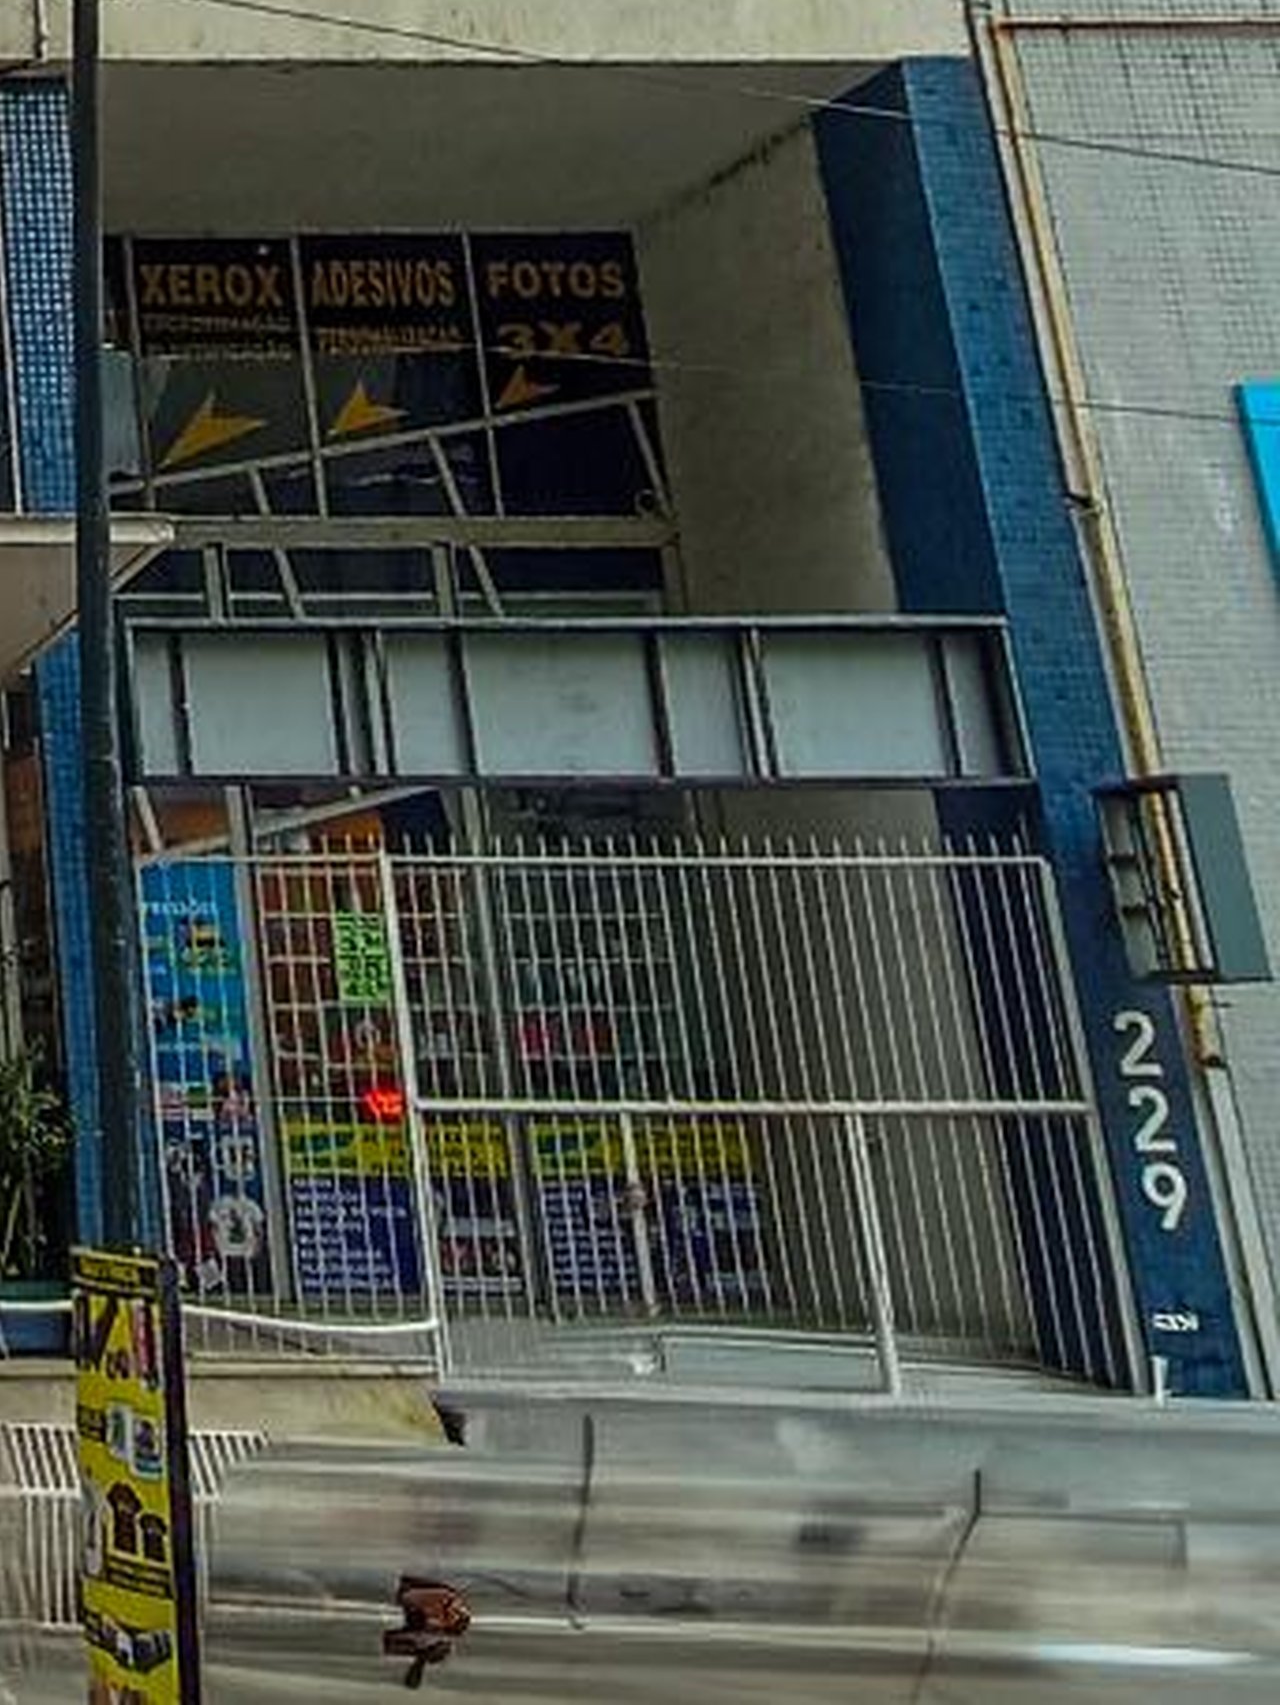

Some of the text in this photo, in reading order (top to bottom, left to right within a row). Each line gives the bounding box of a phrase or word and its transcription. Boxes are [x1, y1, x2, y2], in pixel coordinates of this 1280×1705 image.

[140, 263, 284, 308] XEROX
[311, 259, 455, 309] ADESIVOS
[487, 261, 625, 300] FOTOS
[496, 321, 630, 358] 3X4
[1112, 1010, 1189, 1232] 229
